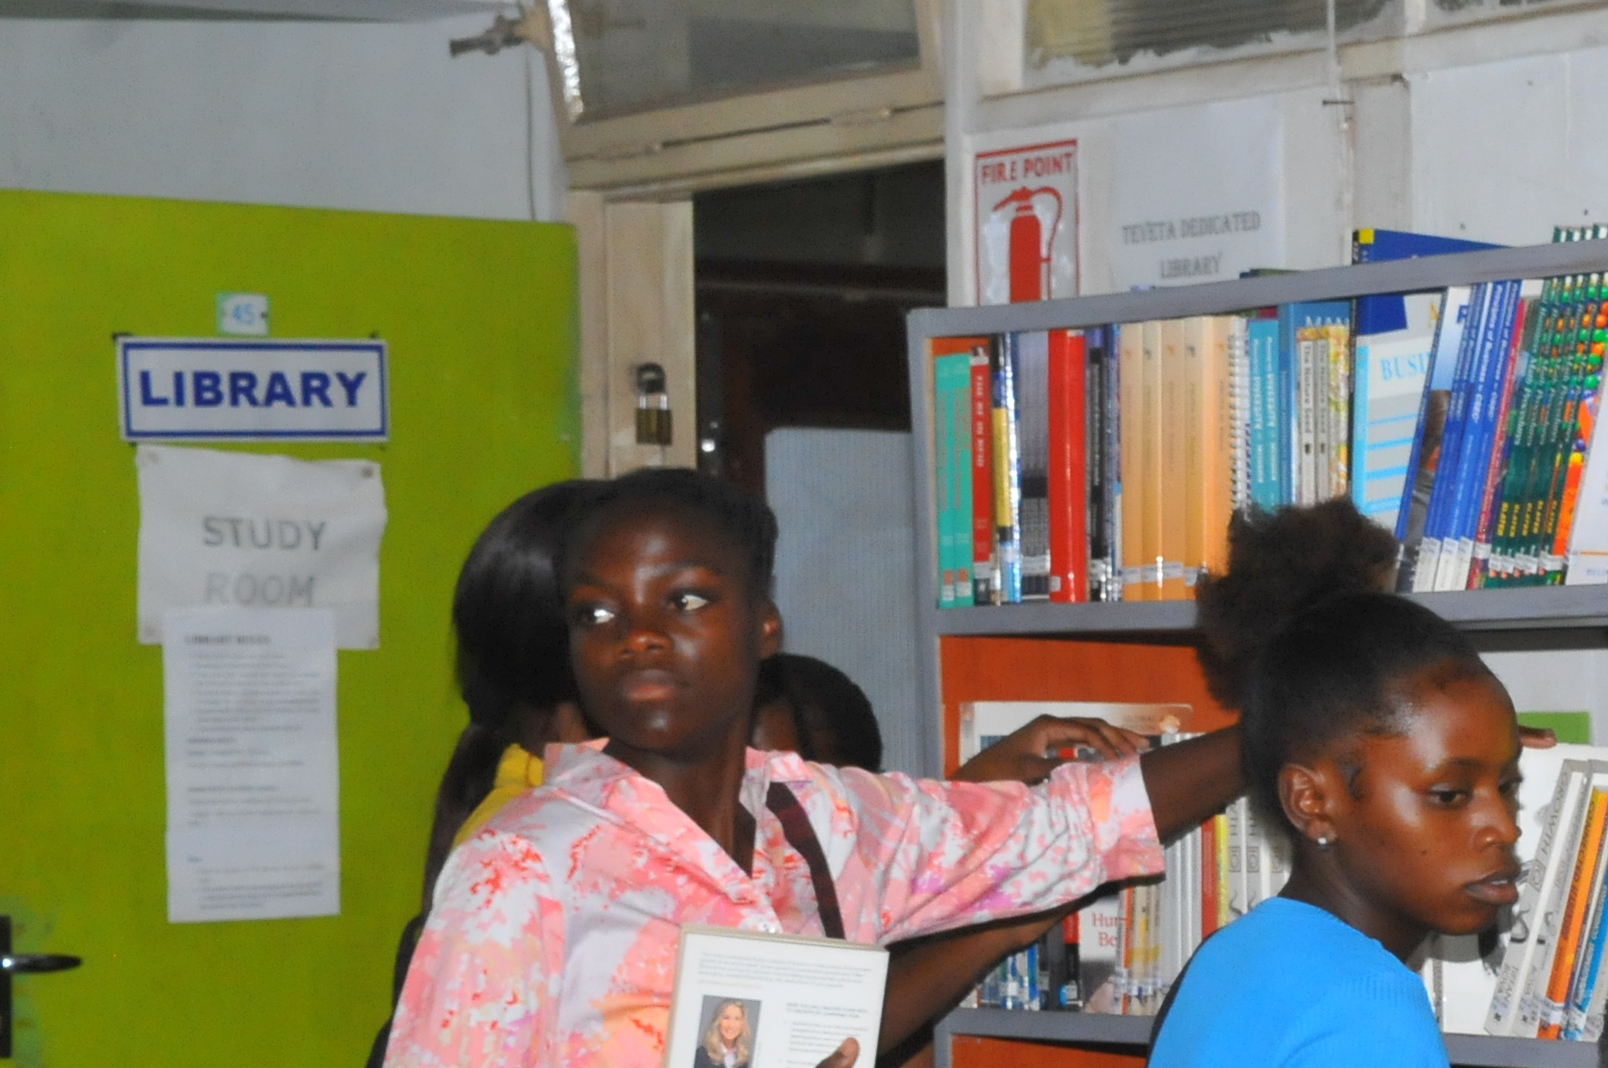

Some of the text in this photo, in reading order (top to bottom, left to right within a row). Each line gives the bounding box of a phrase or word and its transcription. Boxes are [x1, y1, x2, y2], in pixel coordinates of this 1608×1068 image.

[981, 153, 1074, 185] FIRE POINT
[1180, 210, 1262, 237] DEDICATED
[1160, 253, 1222, 279] LIBRARY
[139, 370, 367, 409] LIBRARY
[1513, 387, 1532, 446] Procedures
[202, 516, 326, 552] STUDY
[1497, 502, 1509, 536] SLATER
[205, 573, 316, 608] ROOM
[1540, 771, 1569, 855] GROWTH
